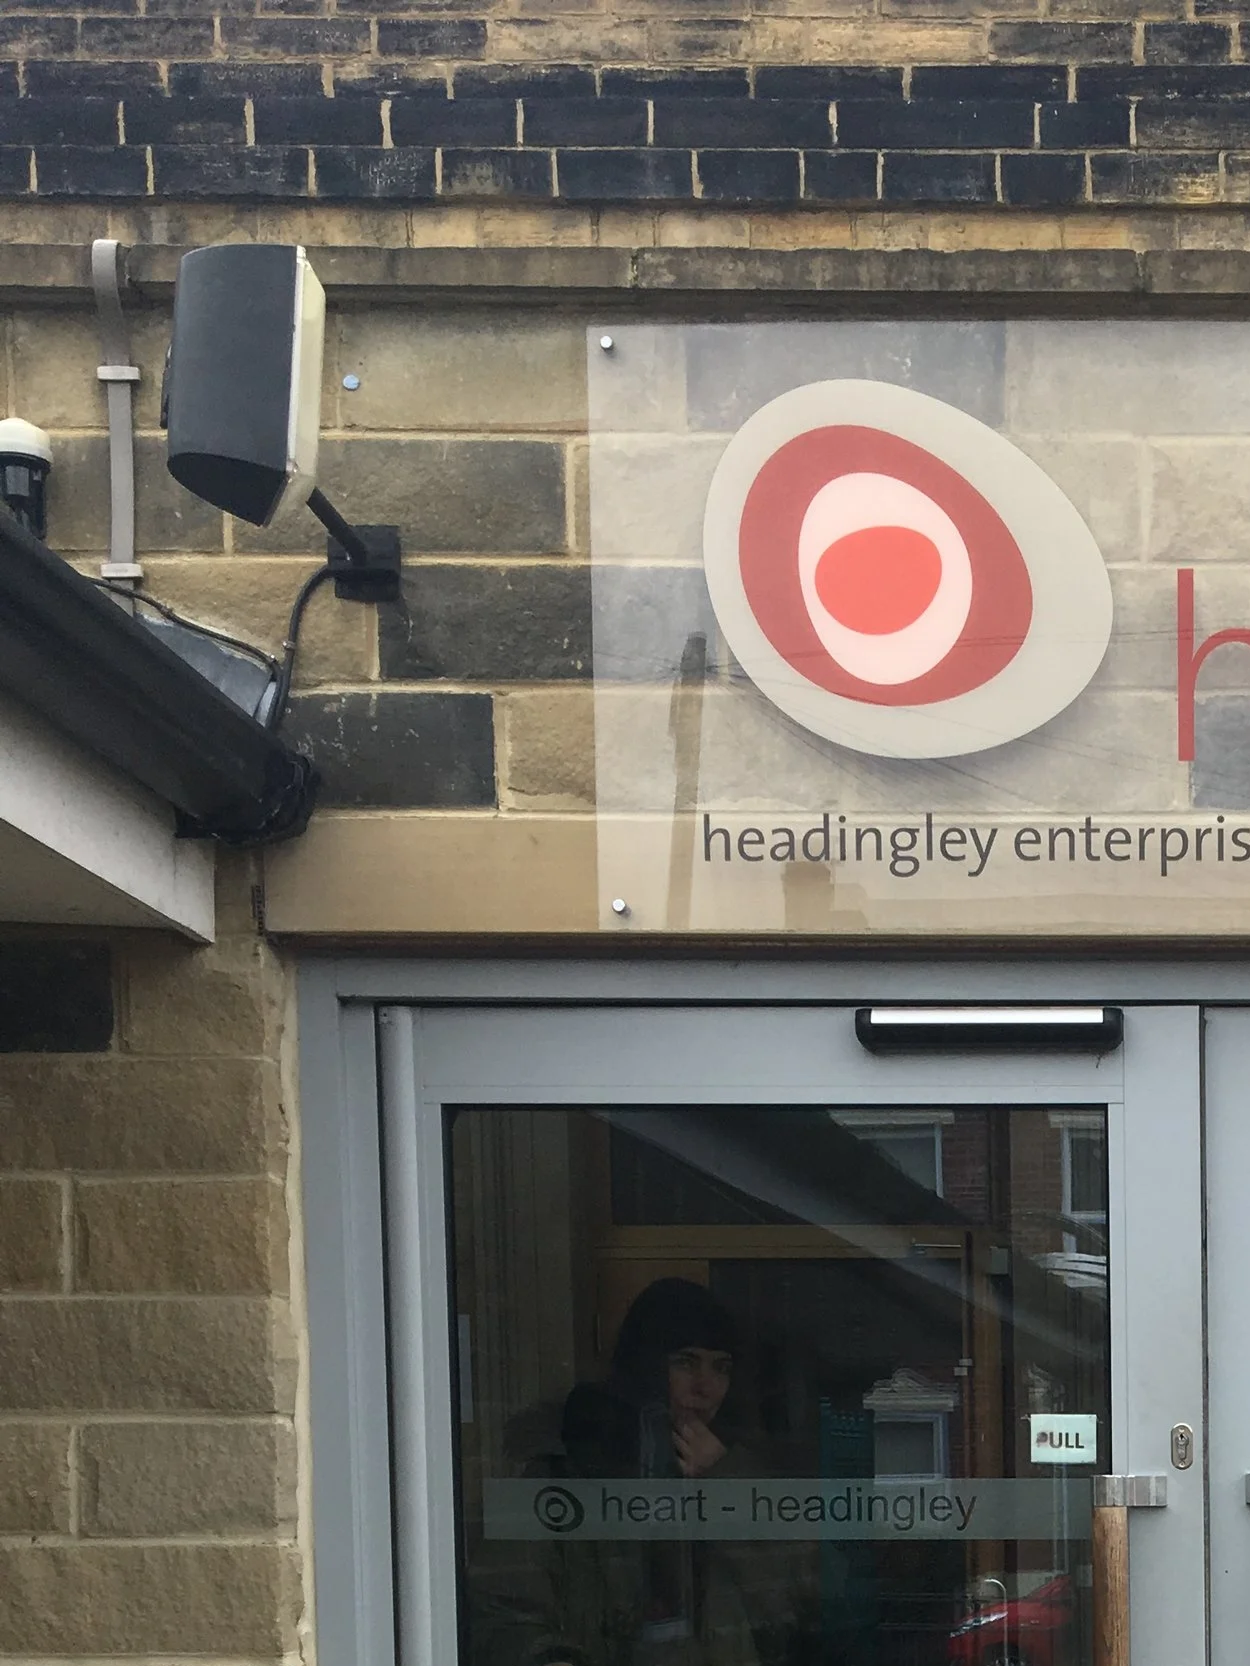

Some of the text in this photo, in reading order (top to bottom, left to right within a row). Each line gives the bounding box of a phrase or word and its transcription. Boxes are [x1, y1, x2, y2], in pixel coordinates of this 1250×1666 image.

[702, 812, 998, 877] headingley
[1036, 1431, 1085, 1449] PULL
[601, 1487, 708, 1523] heart
[751, 1487, 978, 1531] headingley
